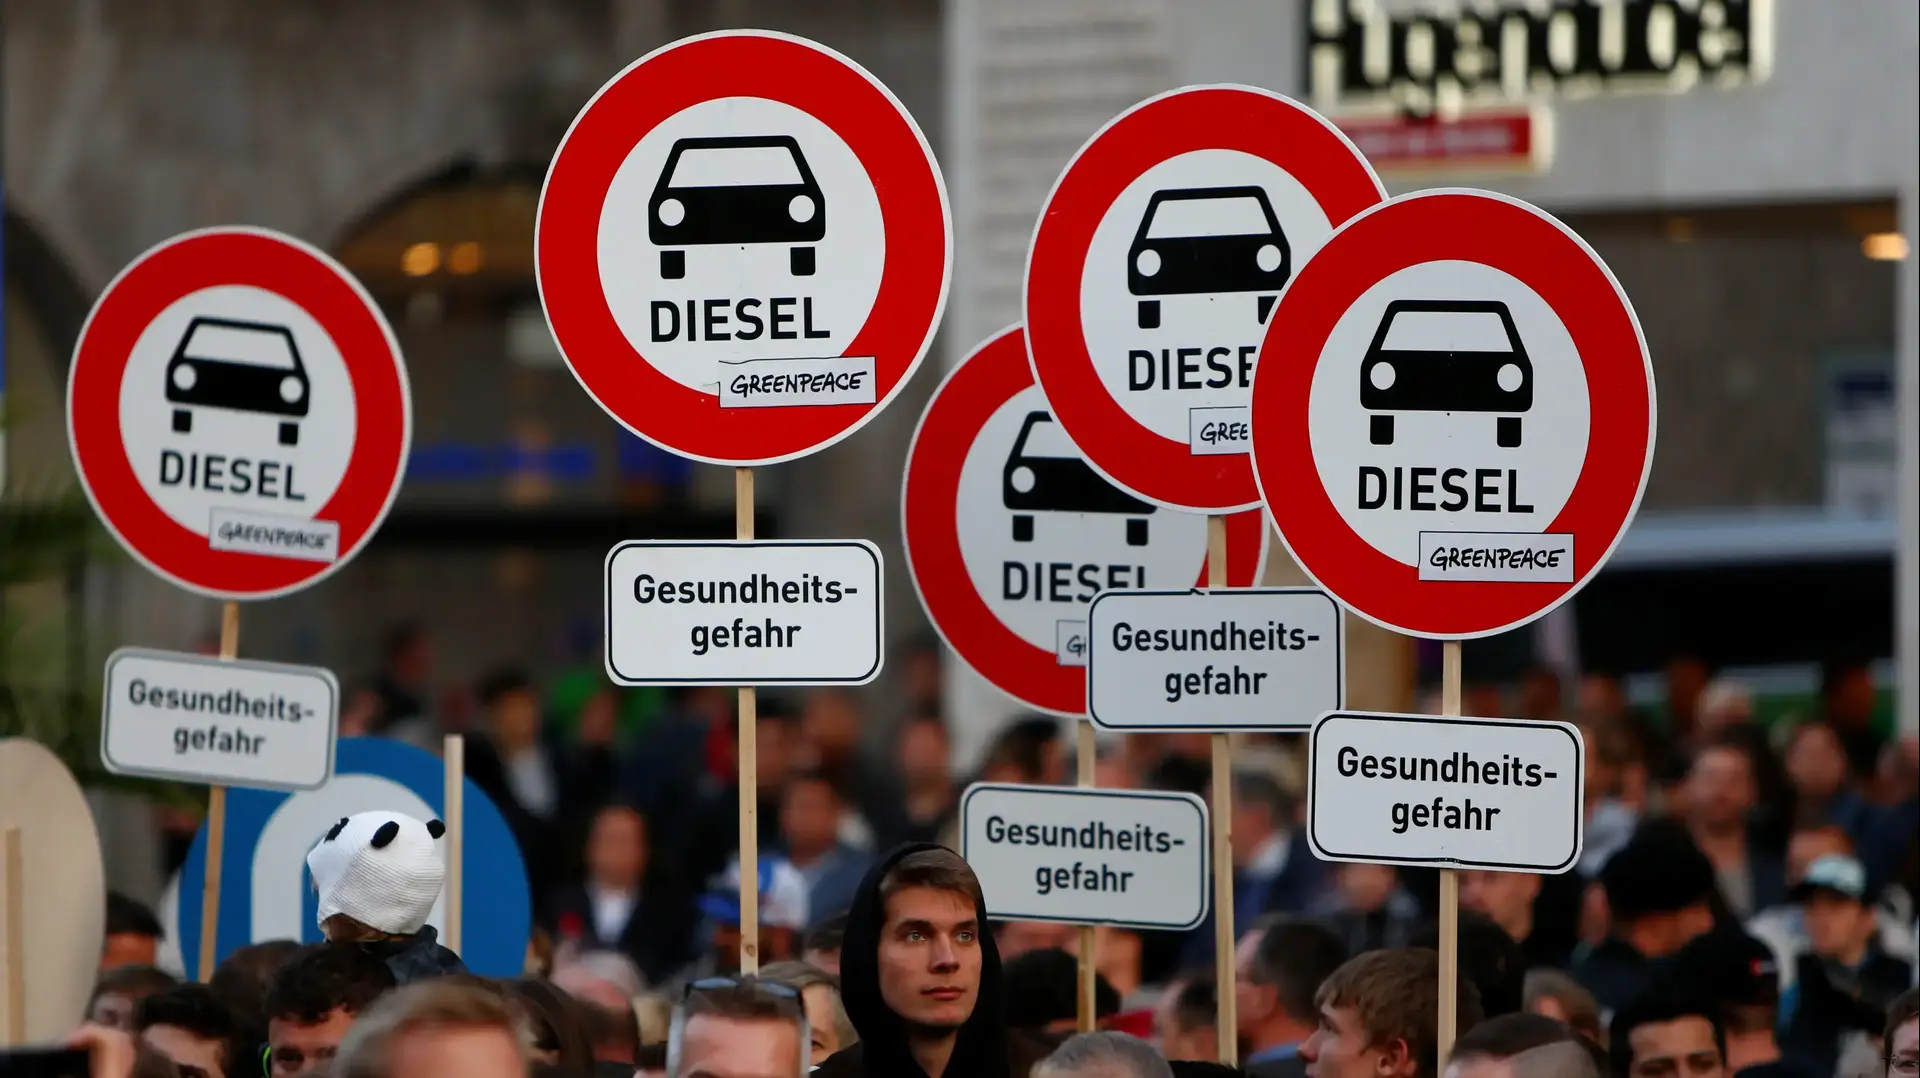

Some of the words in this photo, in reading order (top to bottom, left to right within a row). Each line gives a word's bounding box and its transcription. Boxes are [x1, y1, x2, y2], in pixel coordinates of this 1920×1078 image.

[650, 296, 831, 343] DIESEL
[730, 370, 868, 399] GREENPEACE
[1128, 345, 1257, 391] DIESE
[159, 449, 306, 502] DIESEL
[1358, 465, 1535, 514] DIESEL
[218, 521, 331, 550] GREENPEACE
[1429, 546, 1566, 571] GREENPEACE
[633, 573, 858, 604] Gesundheits-
[691, 617, 802, 656] gefahr
[1112, 620, 1320, 652] Gesundheits-
[128, 678, 316, 722] Gesundheits-
[1165, 664, 1268, 703] gefahr
[173, 724, 265, 756] gefahr
[1337, 745, 1558, 788] Gesundheits-
[985, 815, 1185, 854] Gesundheits-
[1391, 796, 1501, 835] gefahr
[1035, 861, 1134, 896] gefahr
